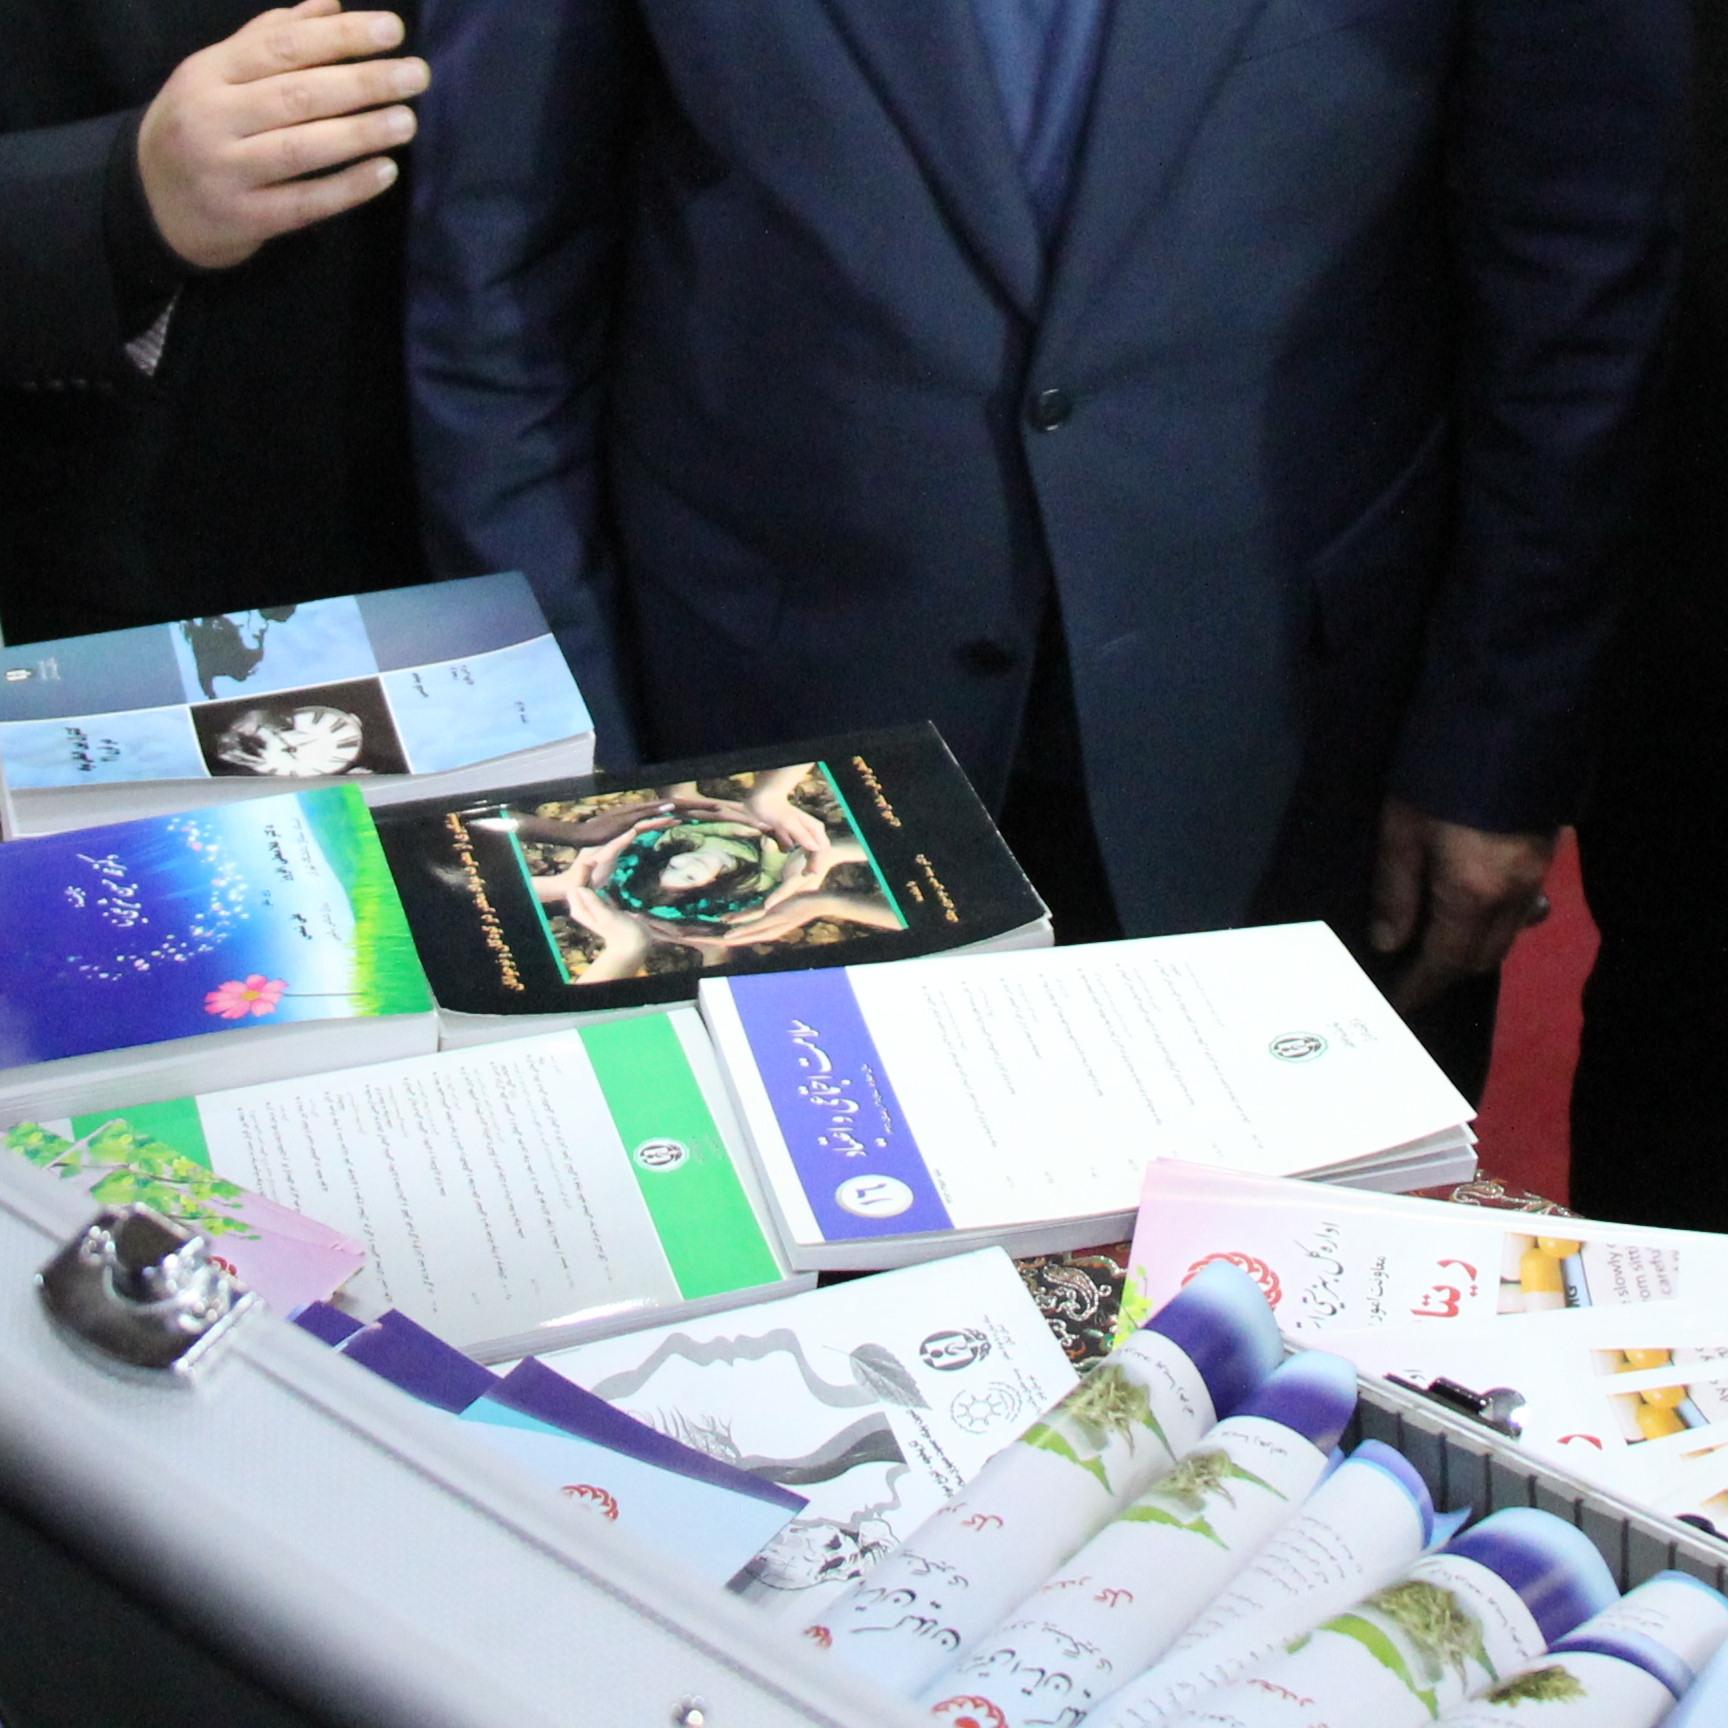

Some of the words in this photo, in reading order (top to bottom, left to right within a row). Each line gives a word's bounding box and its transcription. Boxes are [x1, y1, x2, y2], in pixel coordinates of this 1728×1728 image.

[785, 1019, 833, 1073] سلامت
[797, 1075, 861, 1114] اجتماعی
[831, 1114, 855, 1124] و
[817, 1126, 888, 1158] اعتیاد
[1314, 1221, 1341, 1255] اداره
[1410, 1259, 1479, 1318] ریتا
